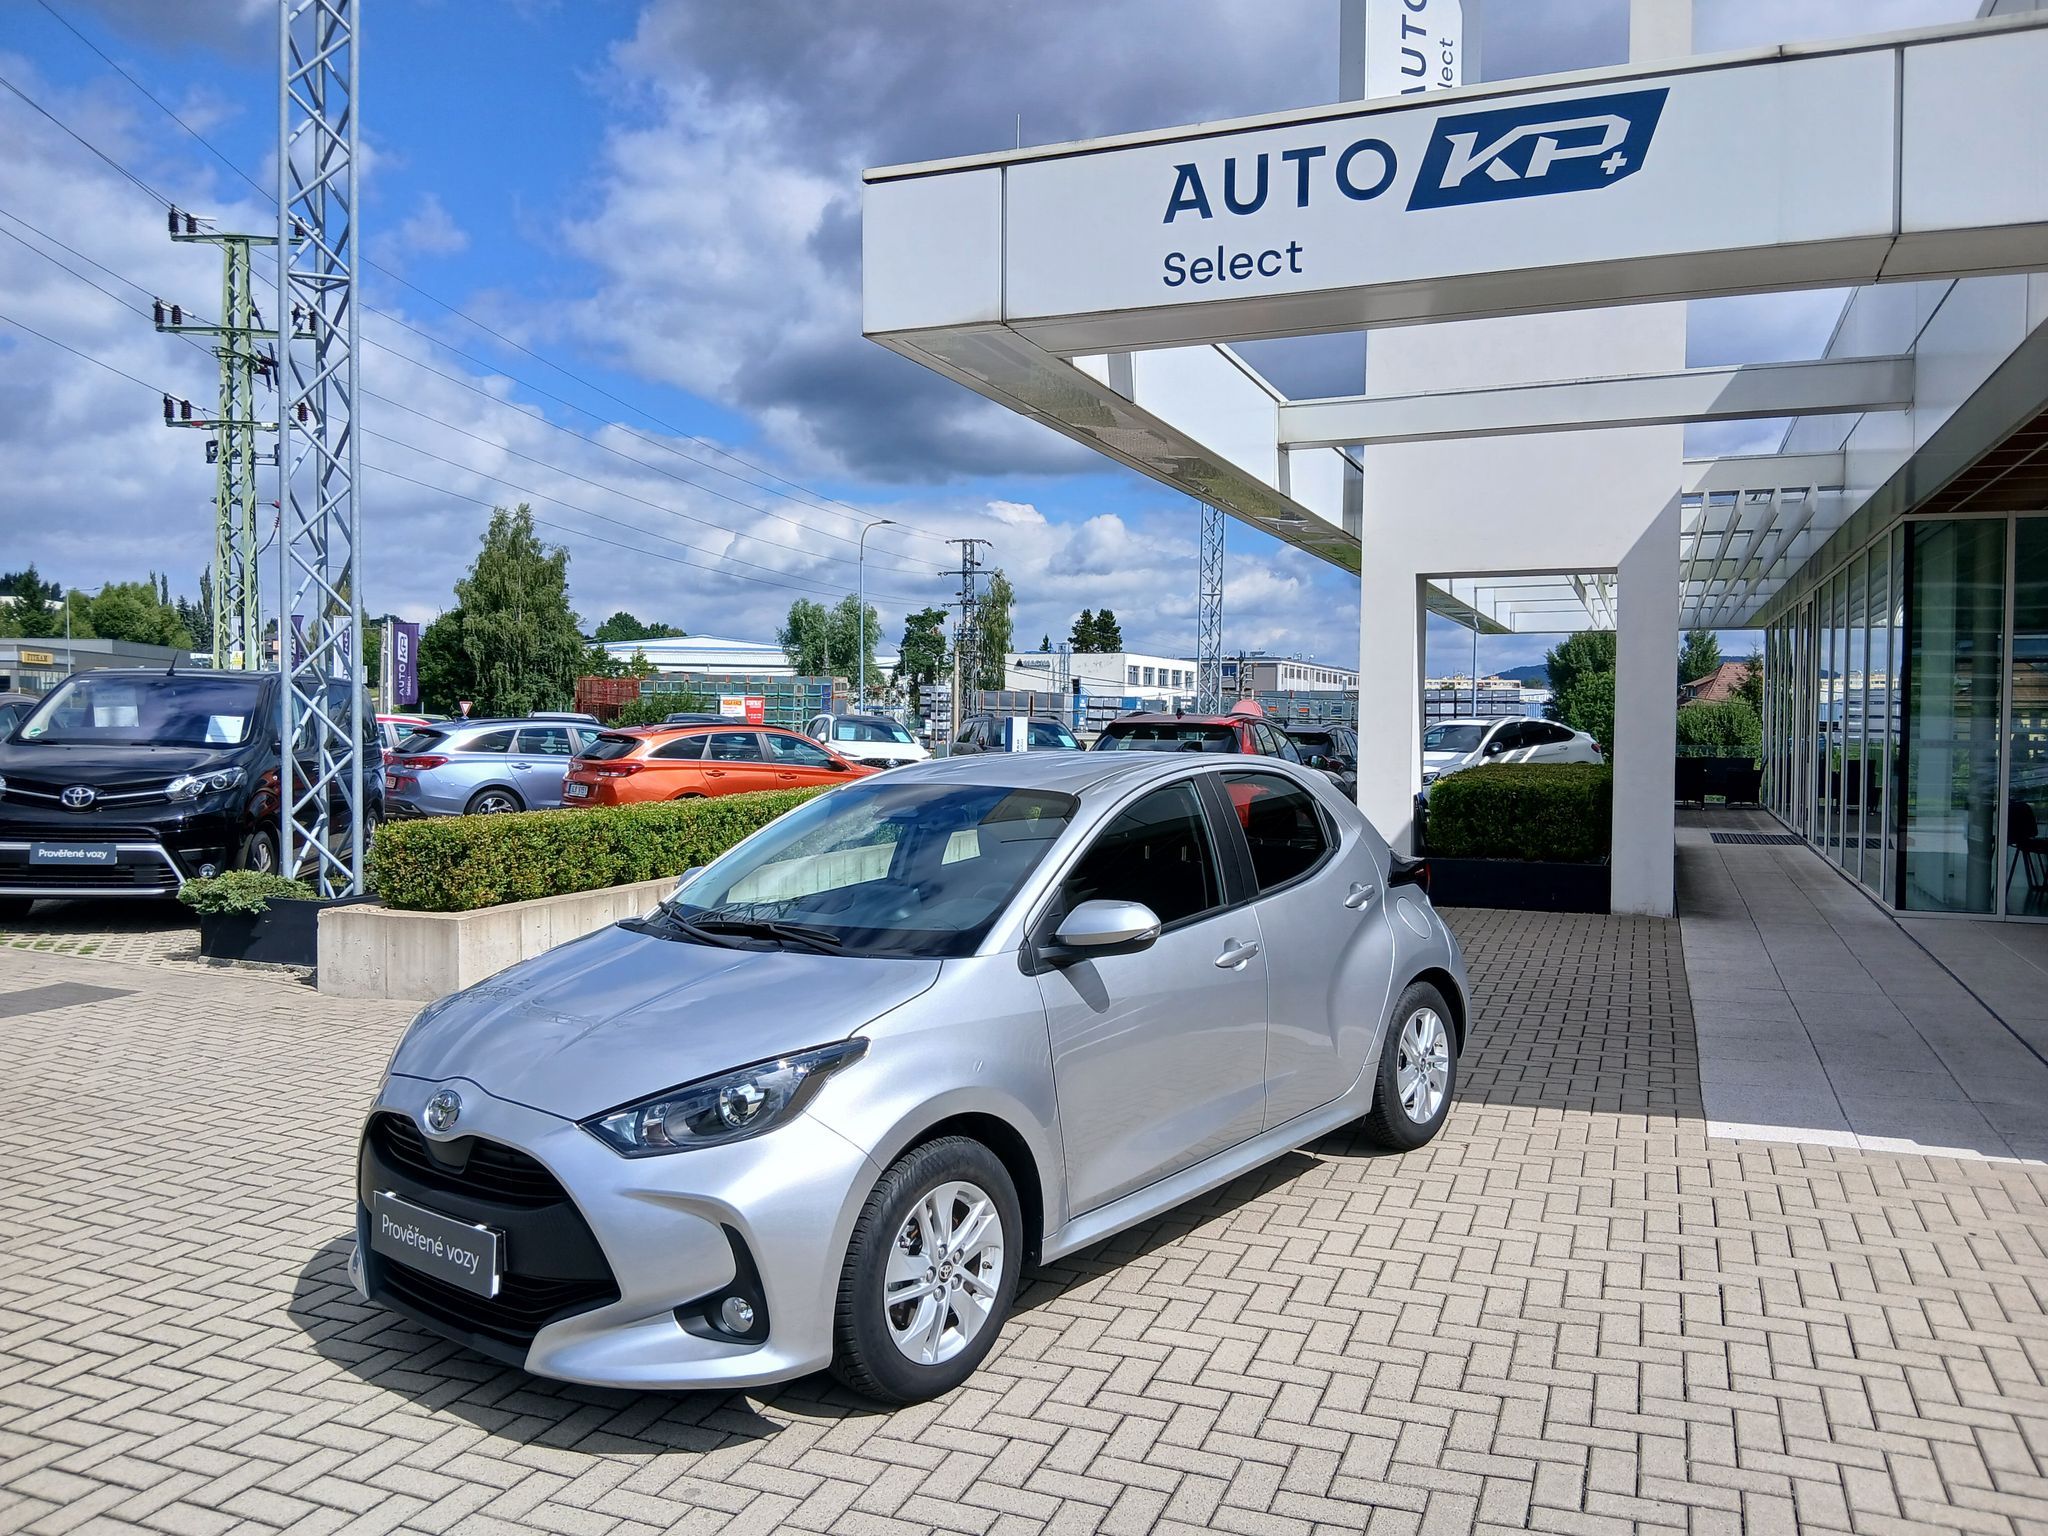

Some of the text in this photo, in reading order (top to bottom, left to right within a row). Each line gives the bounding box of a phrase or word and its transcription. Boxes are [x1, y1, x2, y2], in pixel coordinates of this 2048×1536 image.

[1437, 37, 1453, 88] lect
[1163, 138, 1398, 224] AUTO
[1163, 241, 1304, 287] Select
[398, 663, 406, 696] AUTO
[38, 848, 108, 860] Prověřené vozy
[382, 1213, 480, 1275] Prověřené vozy
